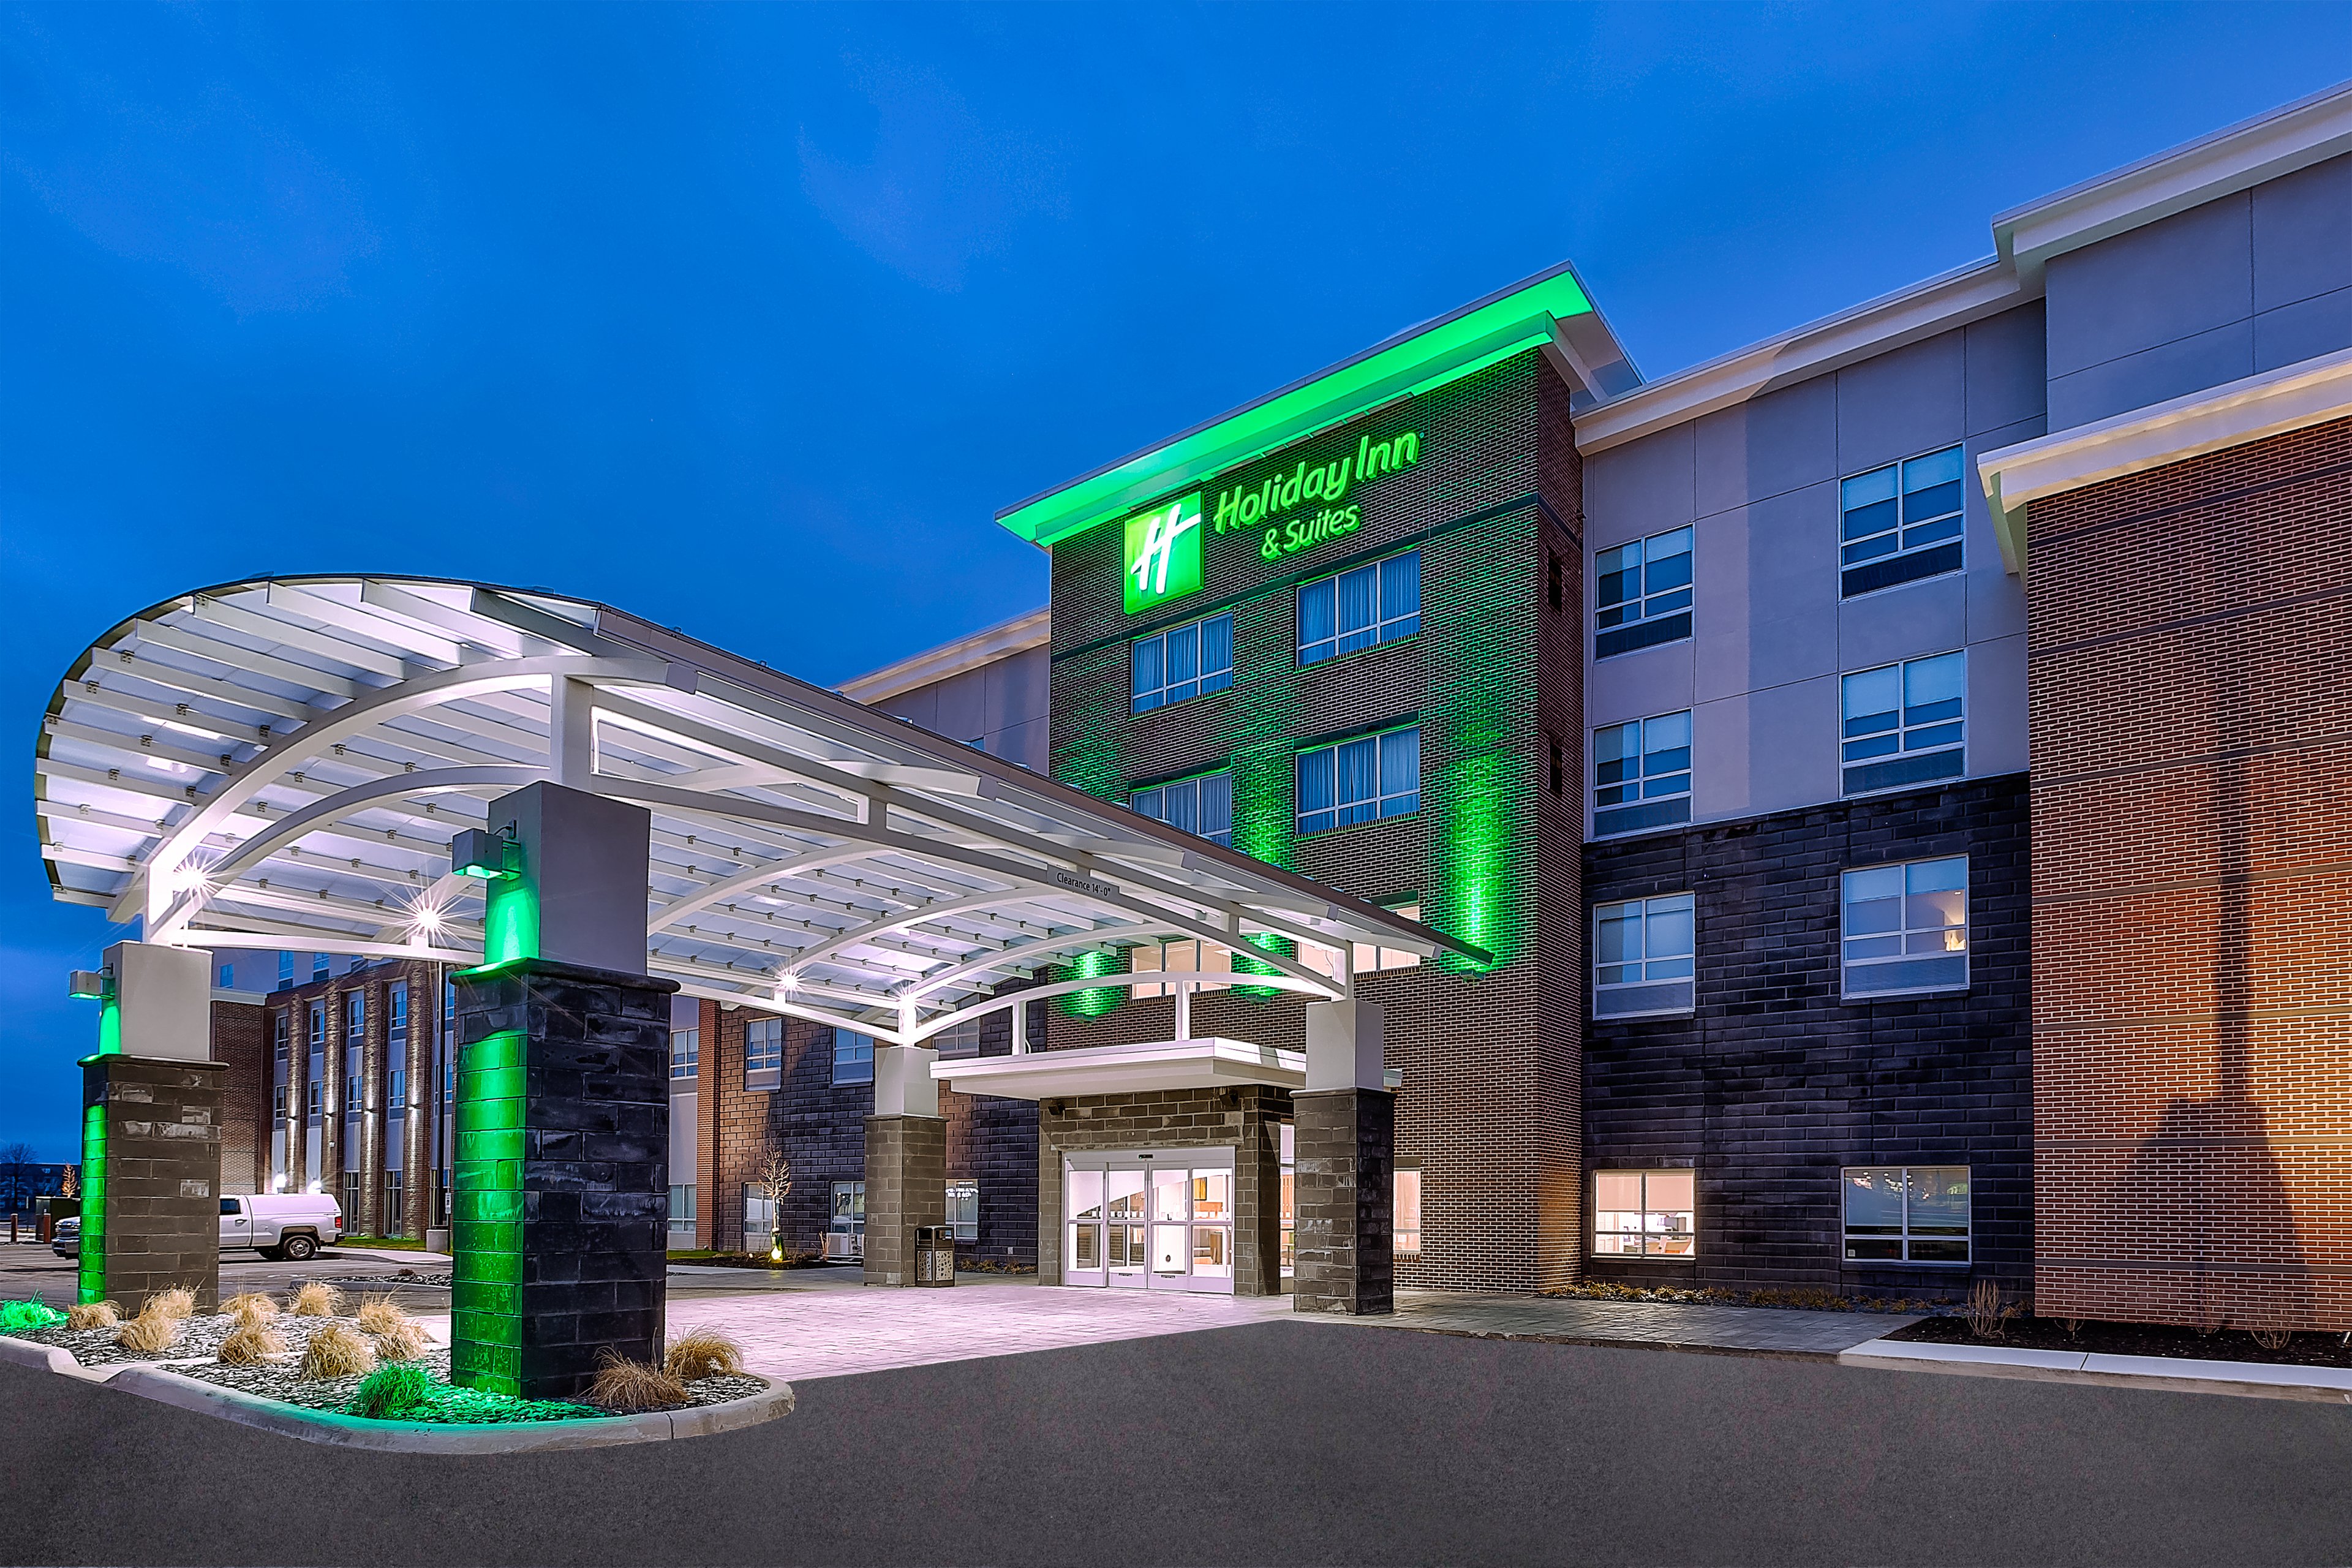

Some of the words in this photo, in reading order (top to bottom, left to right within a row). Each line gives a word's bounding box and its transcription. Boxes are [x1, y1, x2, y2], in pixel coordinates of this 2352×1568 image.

[1213, 457, 1352, 534] Holiday
[1356, 432, 1419, 482] Inn
[1131, 503, 1201, 594] H
[1262, 529, 1282, 559] &
[1284, 505, 1361, 551] Suites
[1057, 872, 1090, 891] Clearance
